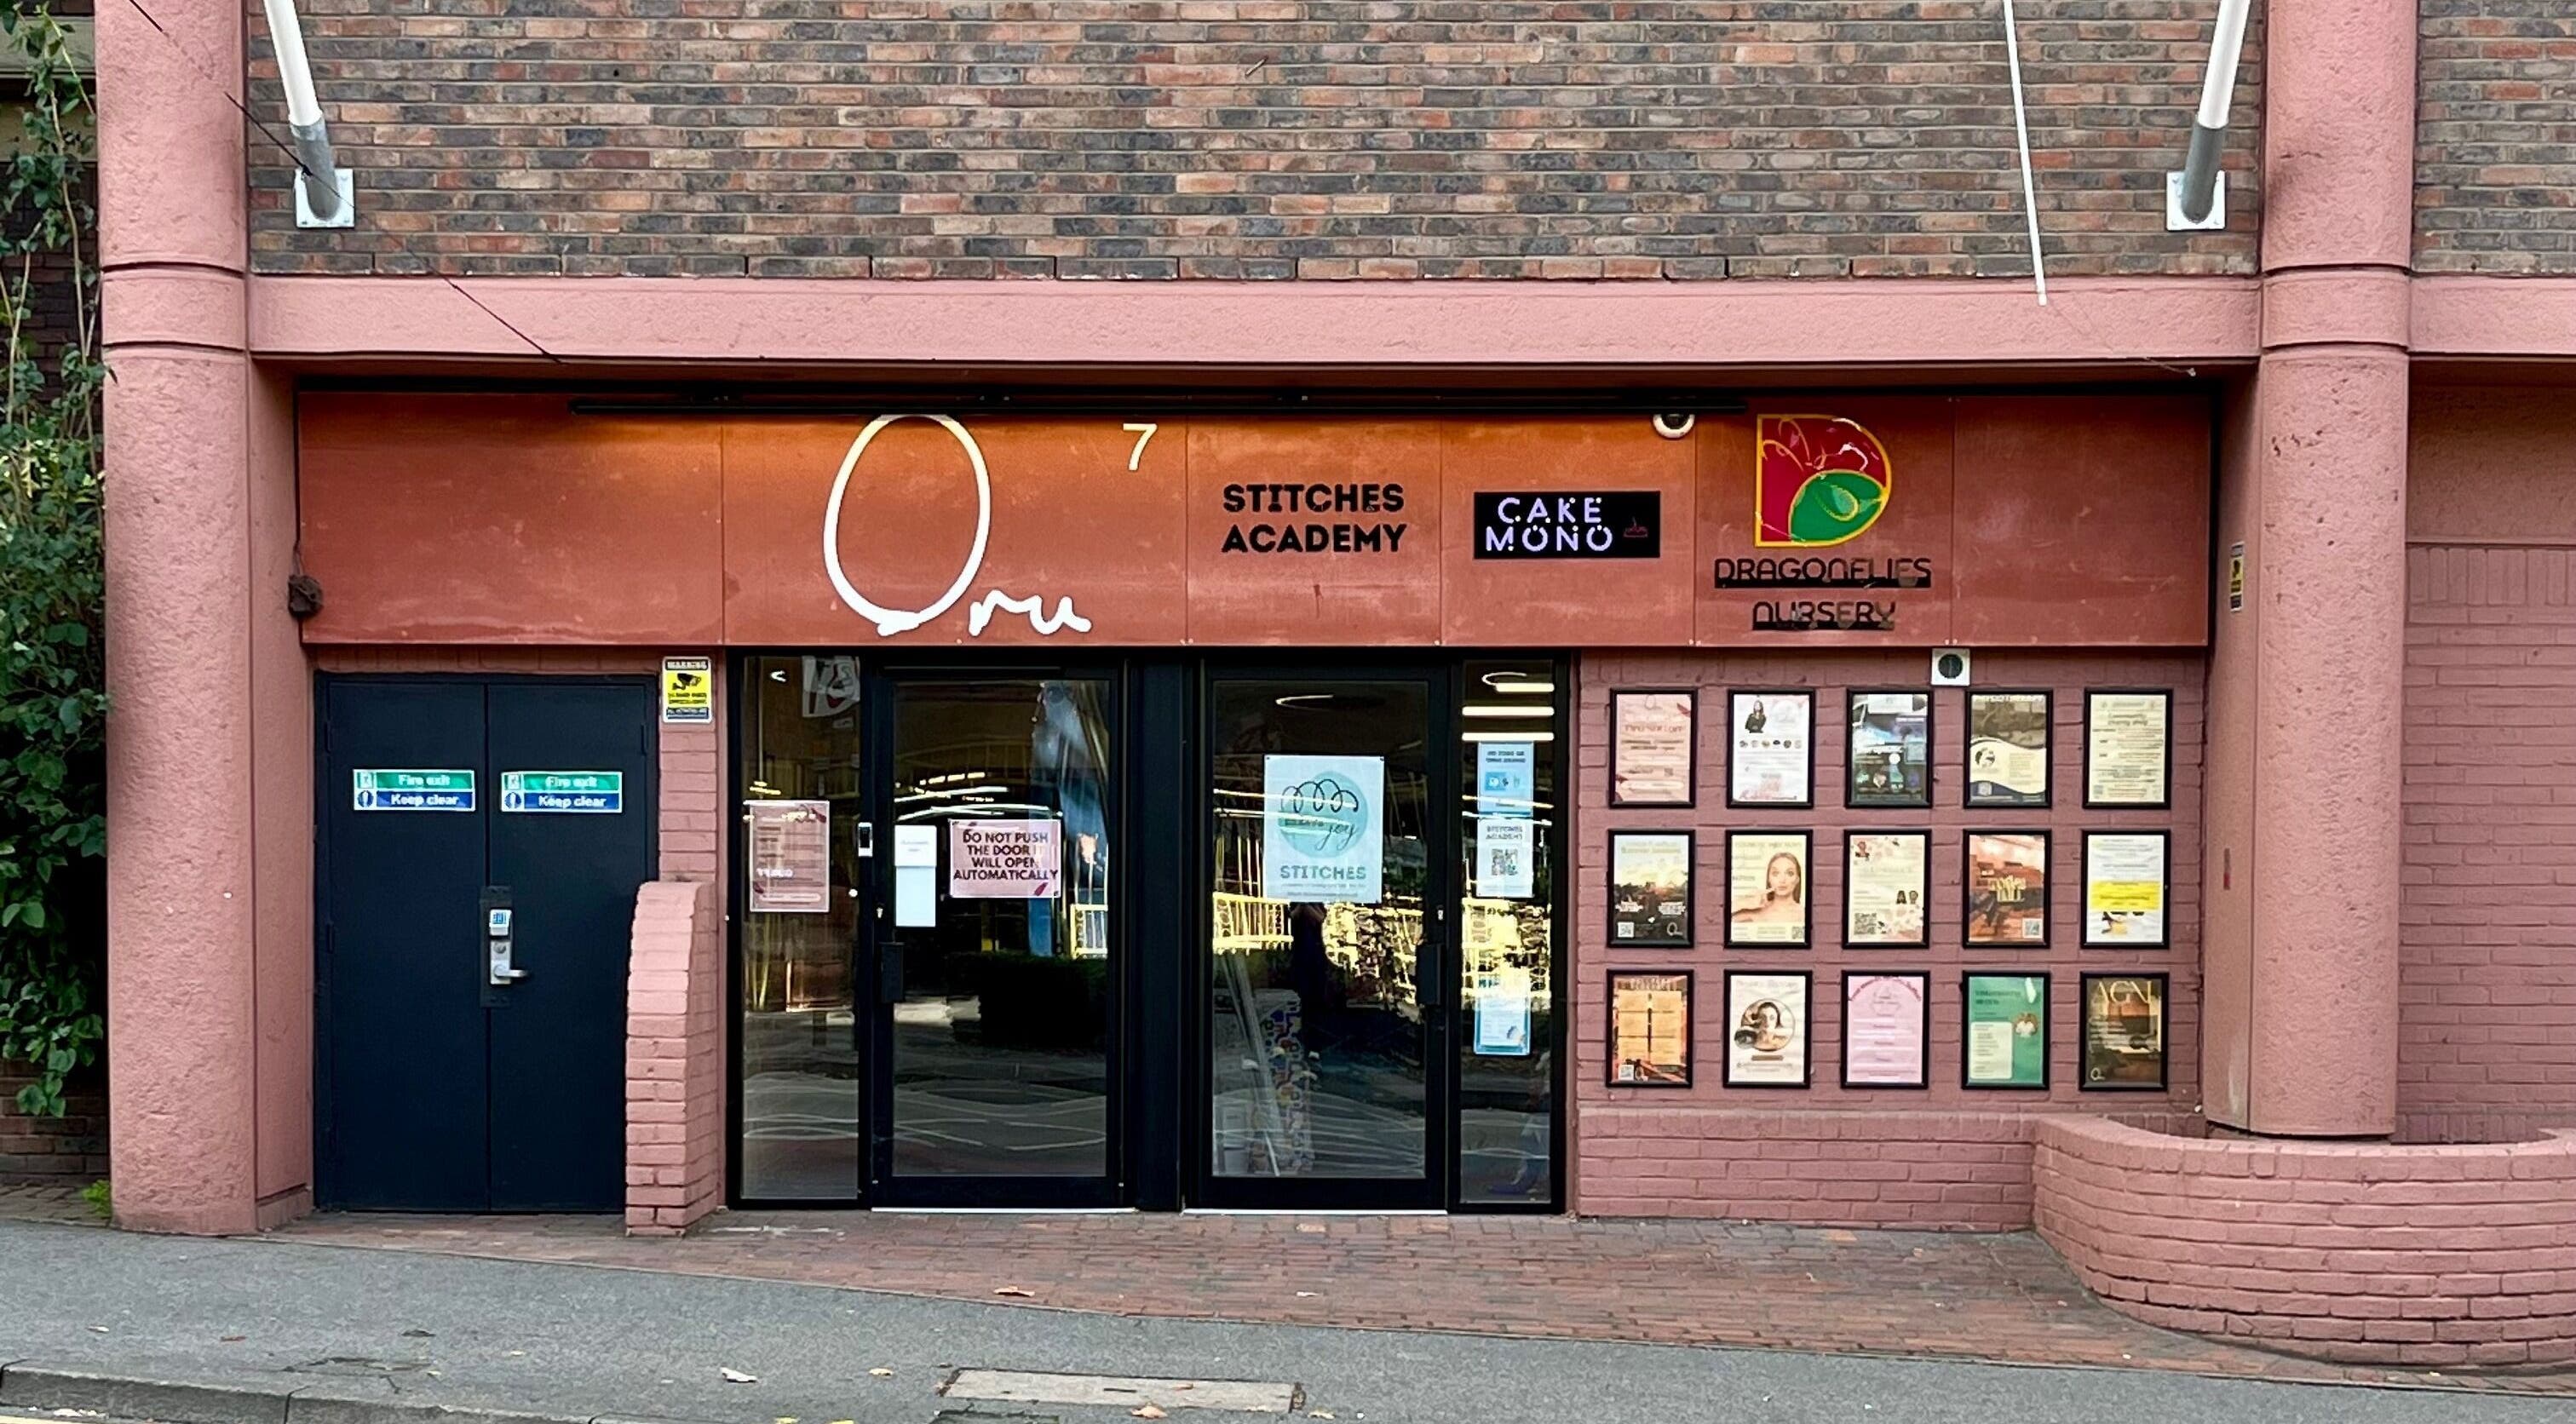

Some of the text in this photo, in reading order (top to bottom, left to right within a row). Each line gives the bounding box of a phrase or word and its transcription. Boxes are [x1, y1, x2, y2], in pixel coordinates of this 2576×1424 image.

[1123, 423, 1157, 471] 7
[1223, 483, 1405, 513] STITCHES
[1498, 497, 1602, 524] CAKE
[1222, 524, 1407, 553] ACADEMY
[1486, 525, 1613, 552] MONO
[1714, 558, 1931, 586] DRAGONFLIES
[1752, 601, 1895, 629] NURSERY
[398, 774, 451, 786] Fire exit
[545, 776, 597, 788] Fire exit
[390, 794, 459, 807] Keep clear
[538, 795, 606, 808] Keep clear
[963, 831, 1049, 843] DO NOT PUSH
[1315, 821, 1357, 852] joy
[967, 845, 989, 855] THE
[993, 845, 1030, 855] DOOR
[972, 857, 1039, 868] WILL OPEN
[953, 870, 1059, 880] AUTOMATICALLY
[1279, 865, 1367, 881] STITCHES
